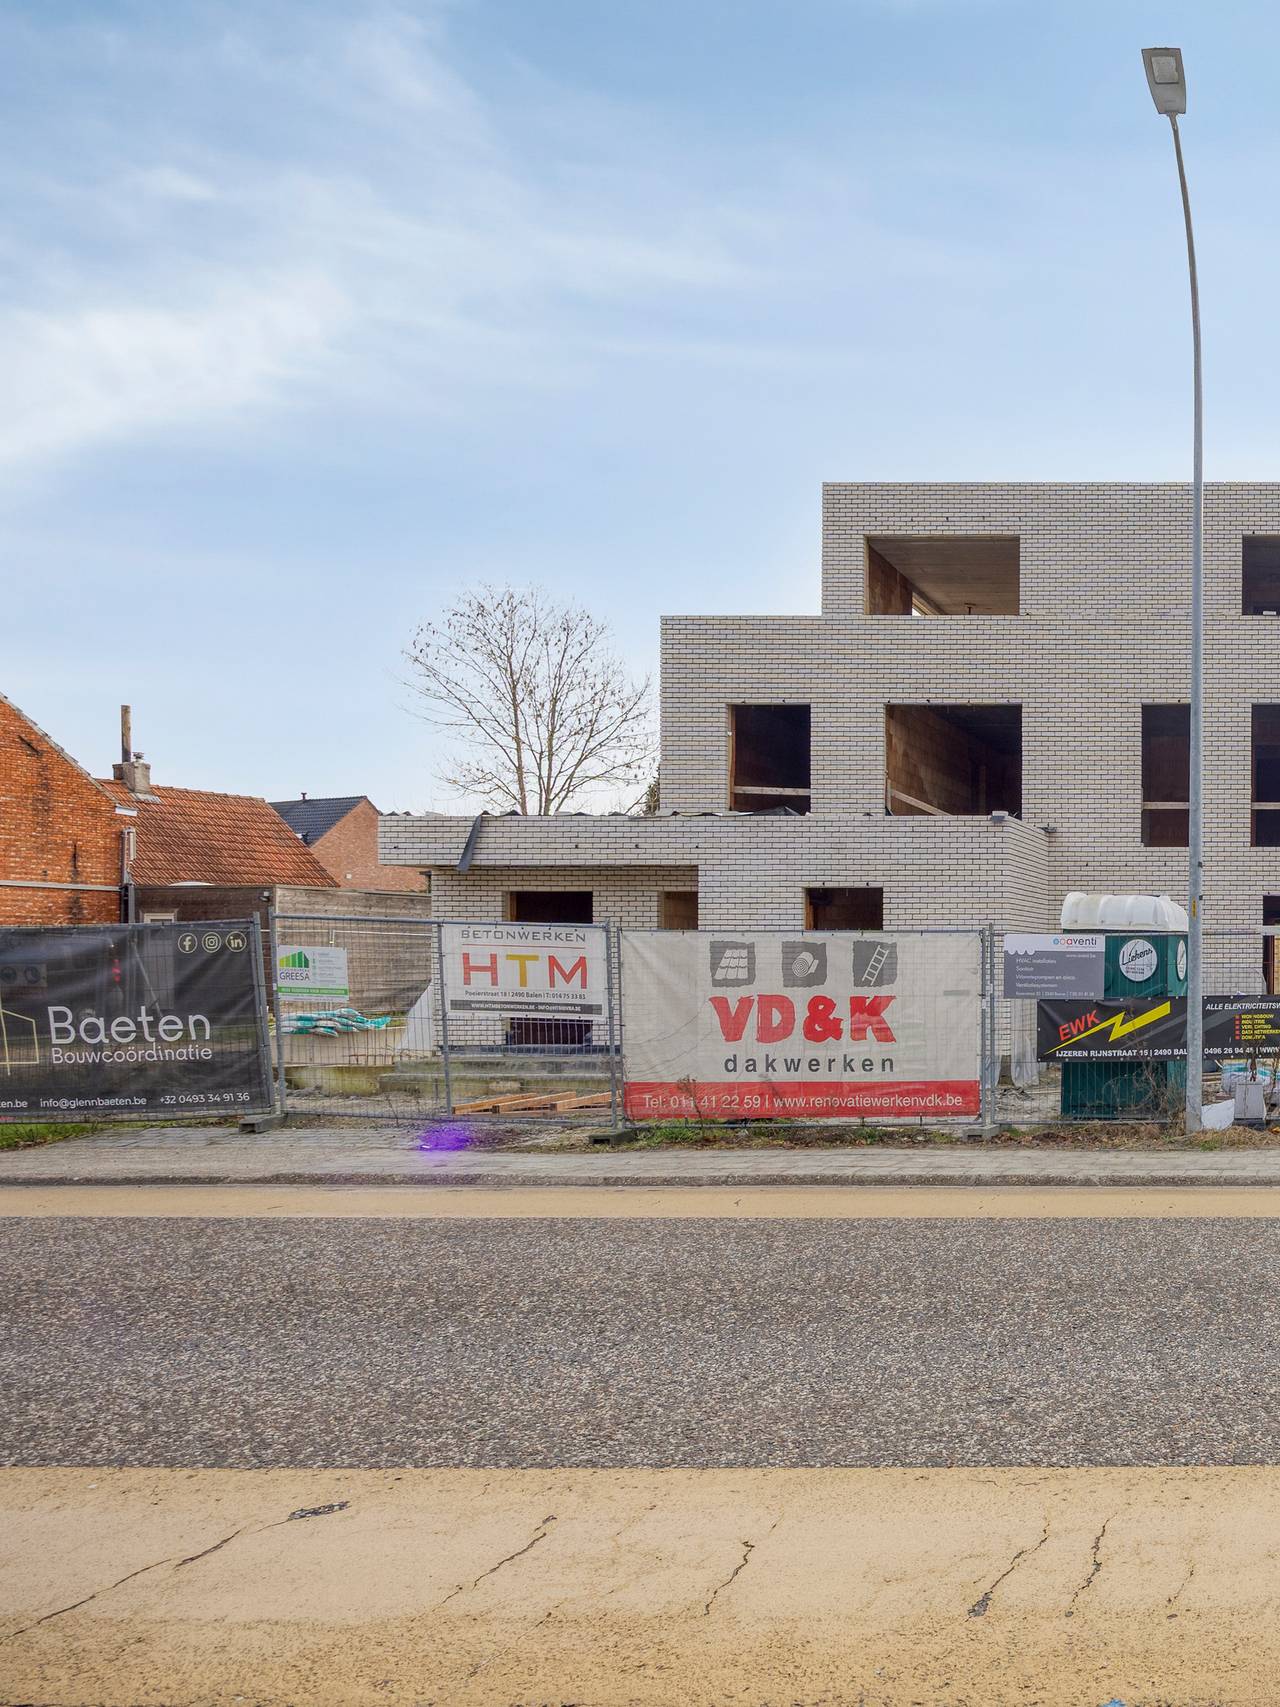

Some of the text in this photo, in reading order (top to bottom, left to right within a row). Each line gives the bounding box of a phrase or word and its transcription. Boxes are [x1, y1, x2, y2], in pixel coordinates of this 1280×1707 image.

[461, 929, 587, 943] BETONWERKEN
[279, 971, 310, 981] GREESA
[462, 952, 588, 990] HTM
[526, 991, 542, 999] Balen
[47, 1005, 211, 1045] Baeten
[709, 994, 897, 1043] VD&K
[1058, 1009, 1101, 1041] EWK
[52, 1042, 213, 1065] Bouwcoördinatie
[724, 1053, 895, 1073] dakwerken
[40, 1096, 147, 1109] info@glennbaeten.be
[160, 1096, 177, 1104] +32
[179, 1094, 206, 1103] 0493
[208, 1093, 220, 1102] 34
[223, 1093, 234, 1102] 91
[236, 1092, 250, 1101] 36
[644, 1094, 963, 1109] Tel: 011 41 22 59 www.renovatiewerkenvdk.be
